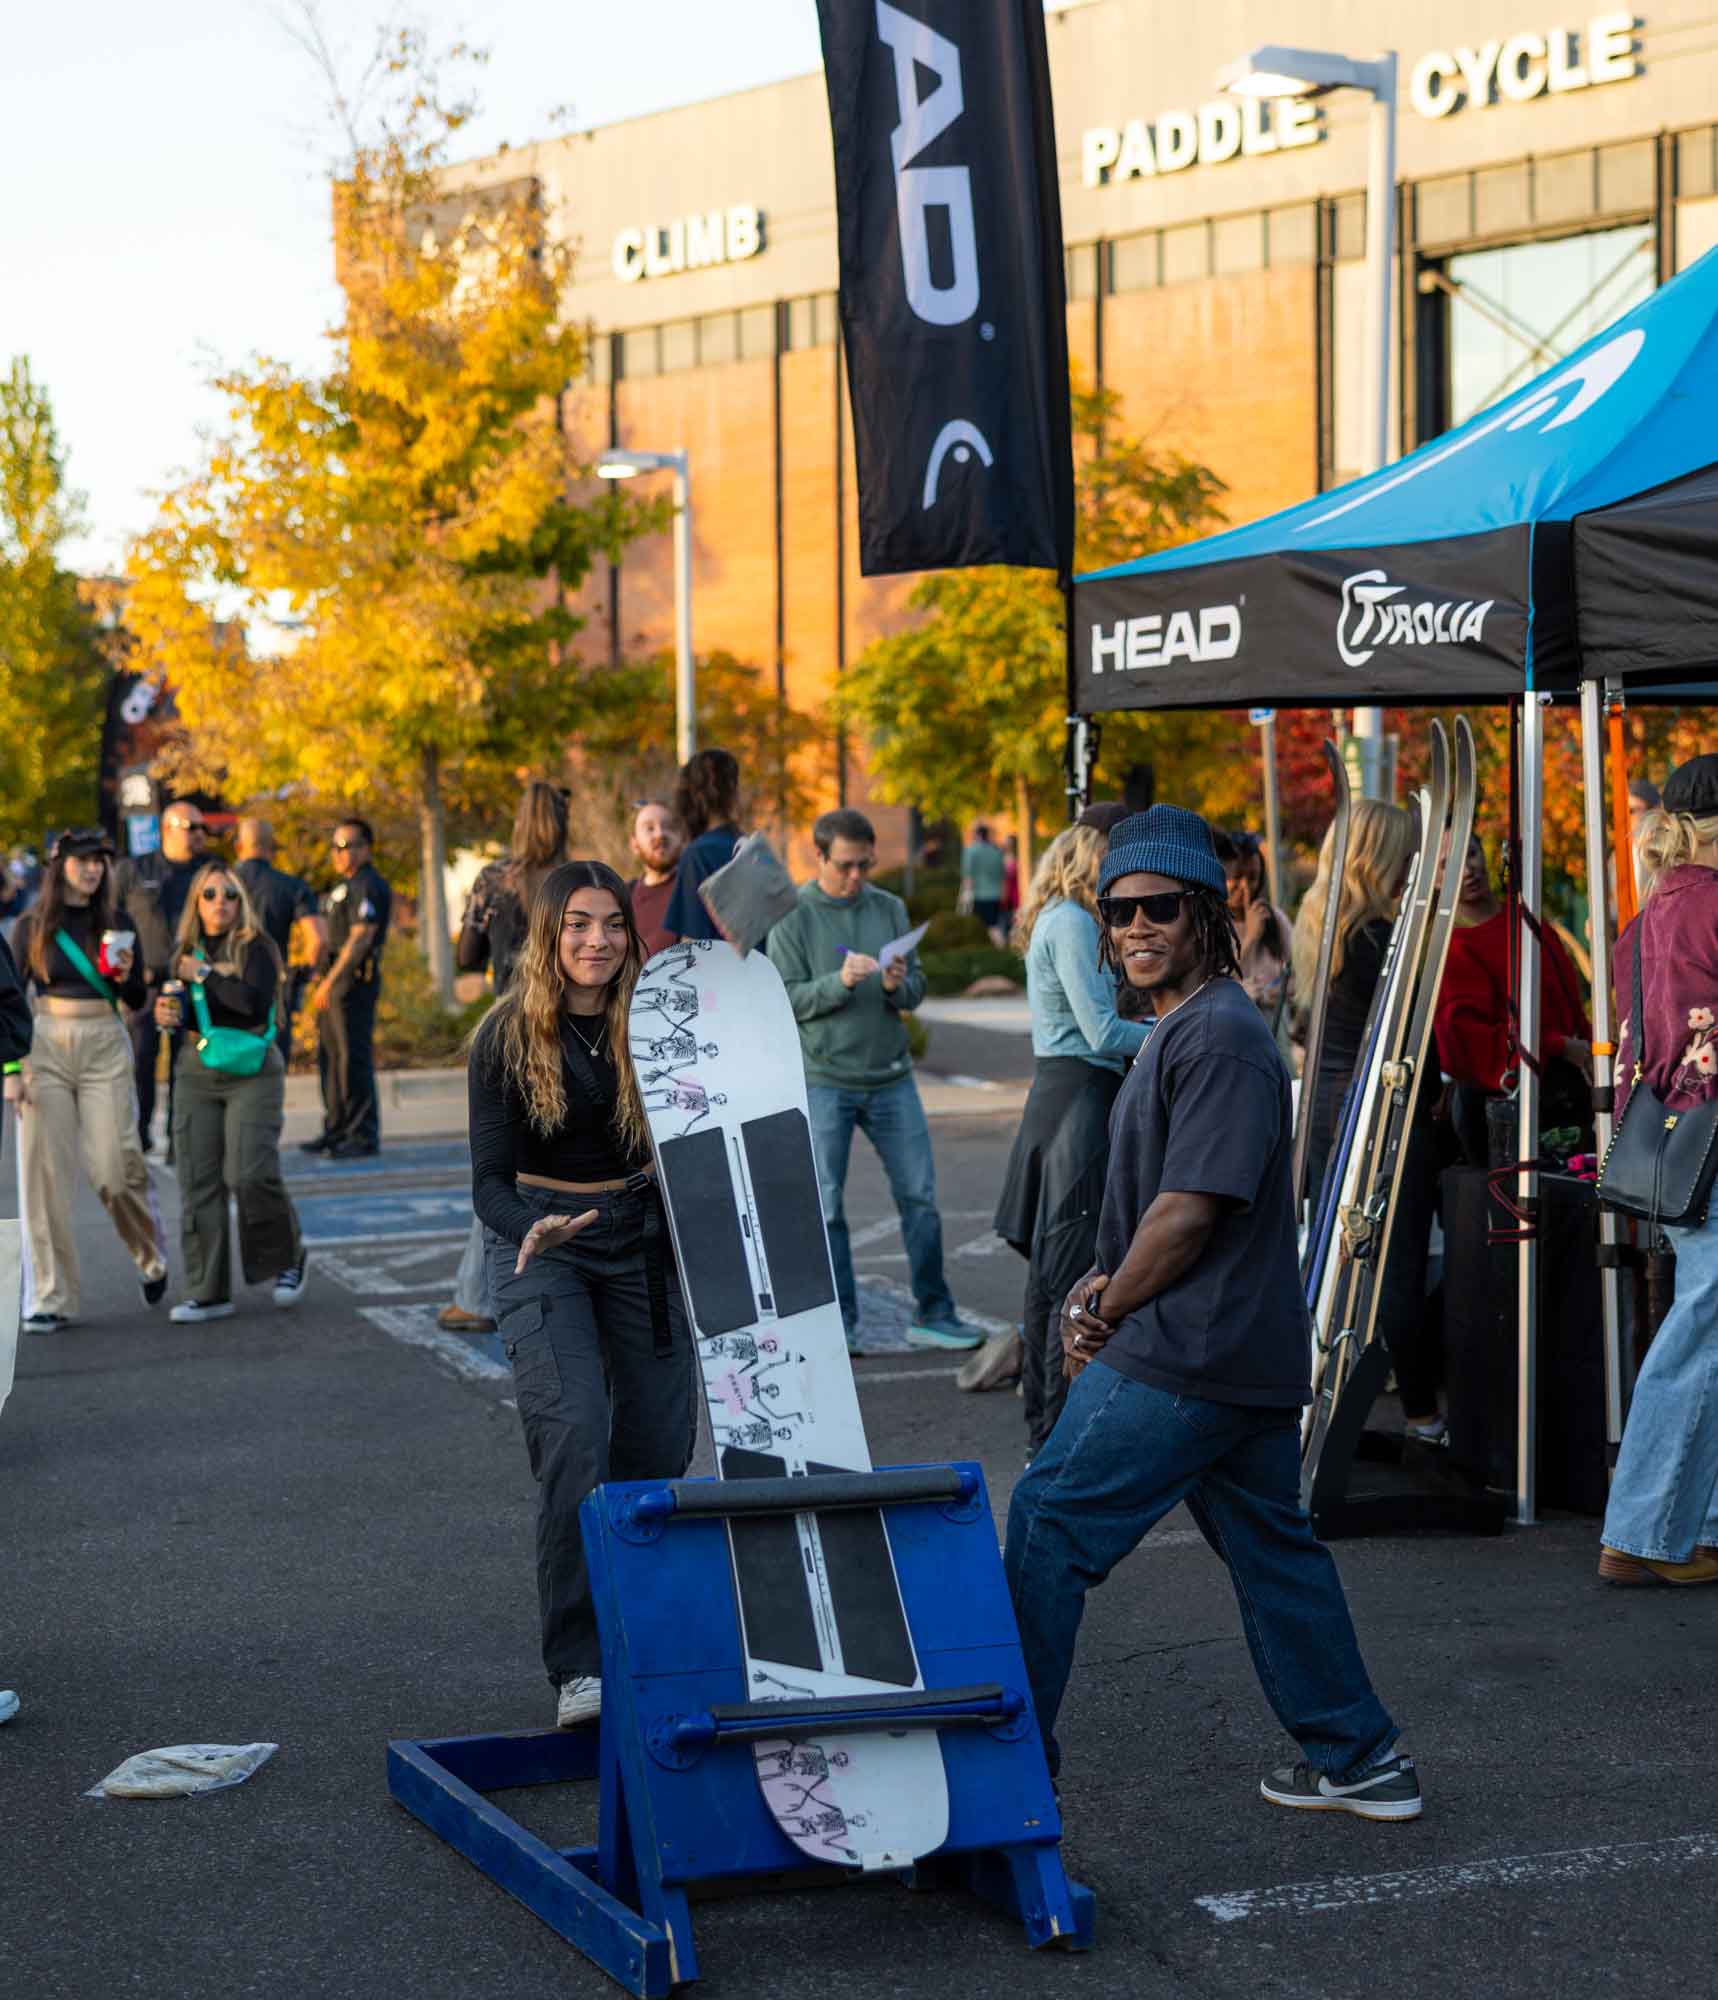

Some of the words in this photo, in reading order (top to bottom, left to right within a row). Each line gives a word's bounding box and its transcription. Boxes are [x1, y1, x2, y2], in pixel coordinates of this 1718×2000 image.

[1411, 14, 1636, 118] CYCLE
[1082, 96, 1320, 187] PADDLE
[612, 202, 760, 282] CLIMB
[1091, 604, 1241, 674] HEAD
[1337, 570, 1494, 667] TYROLIA
